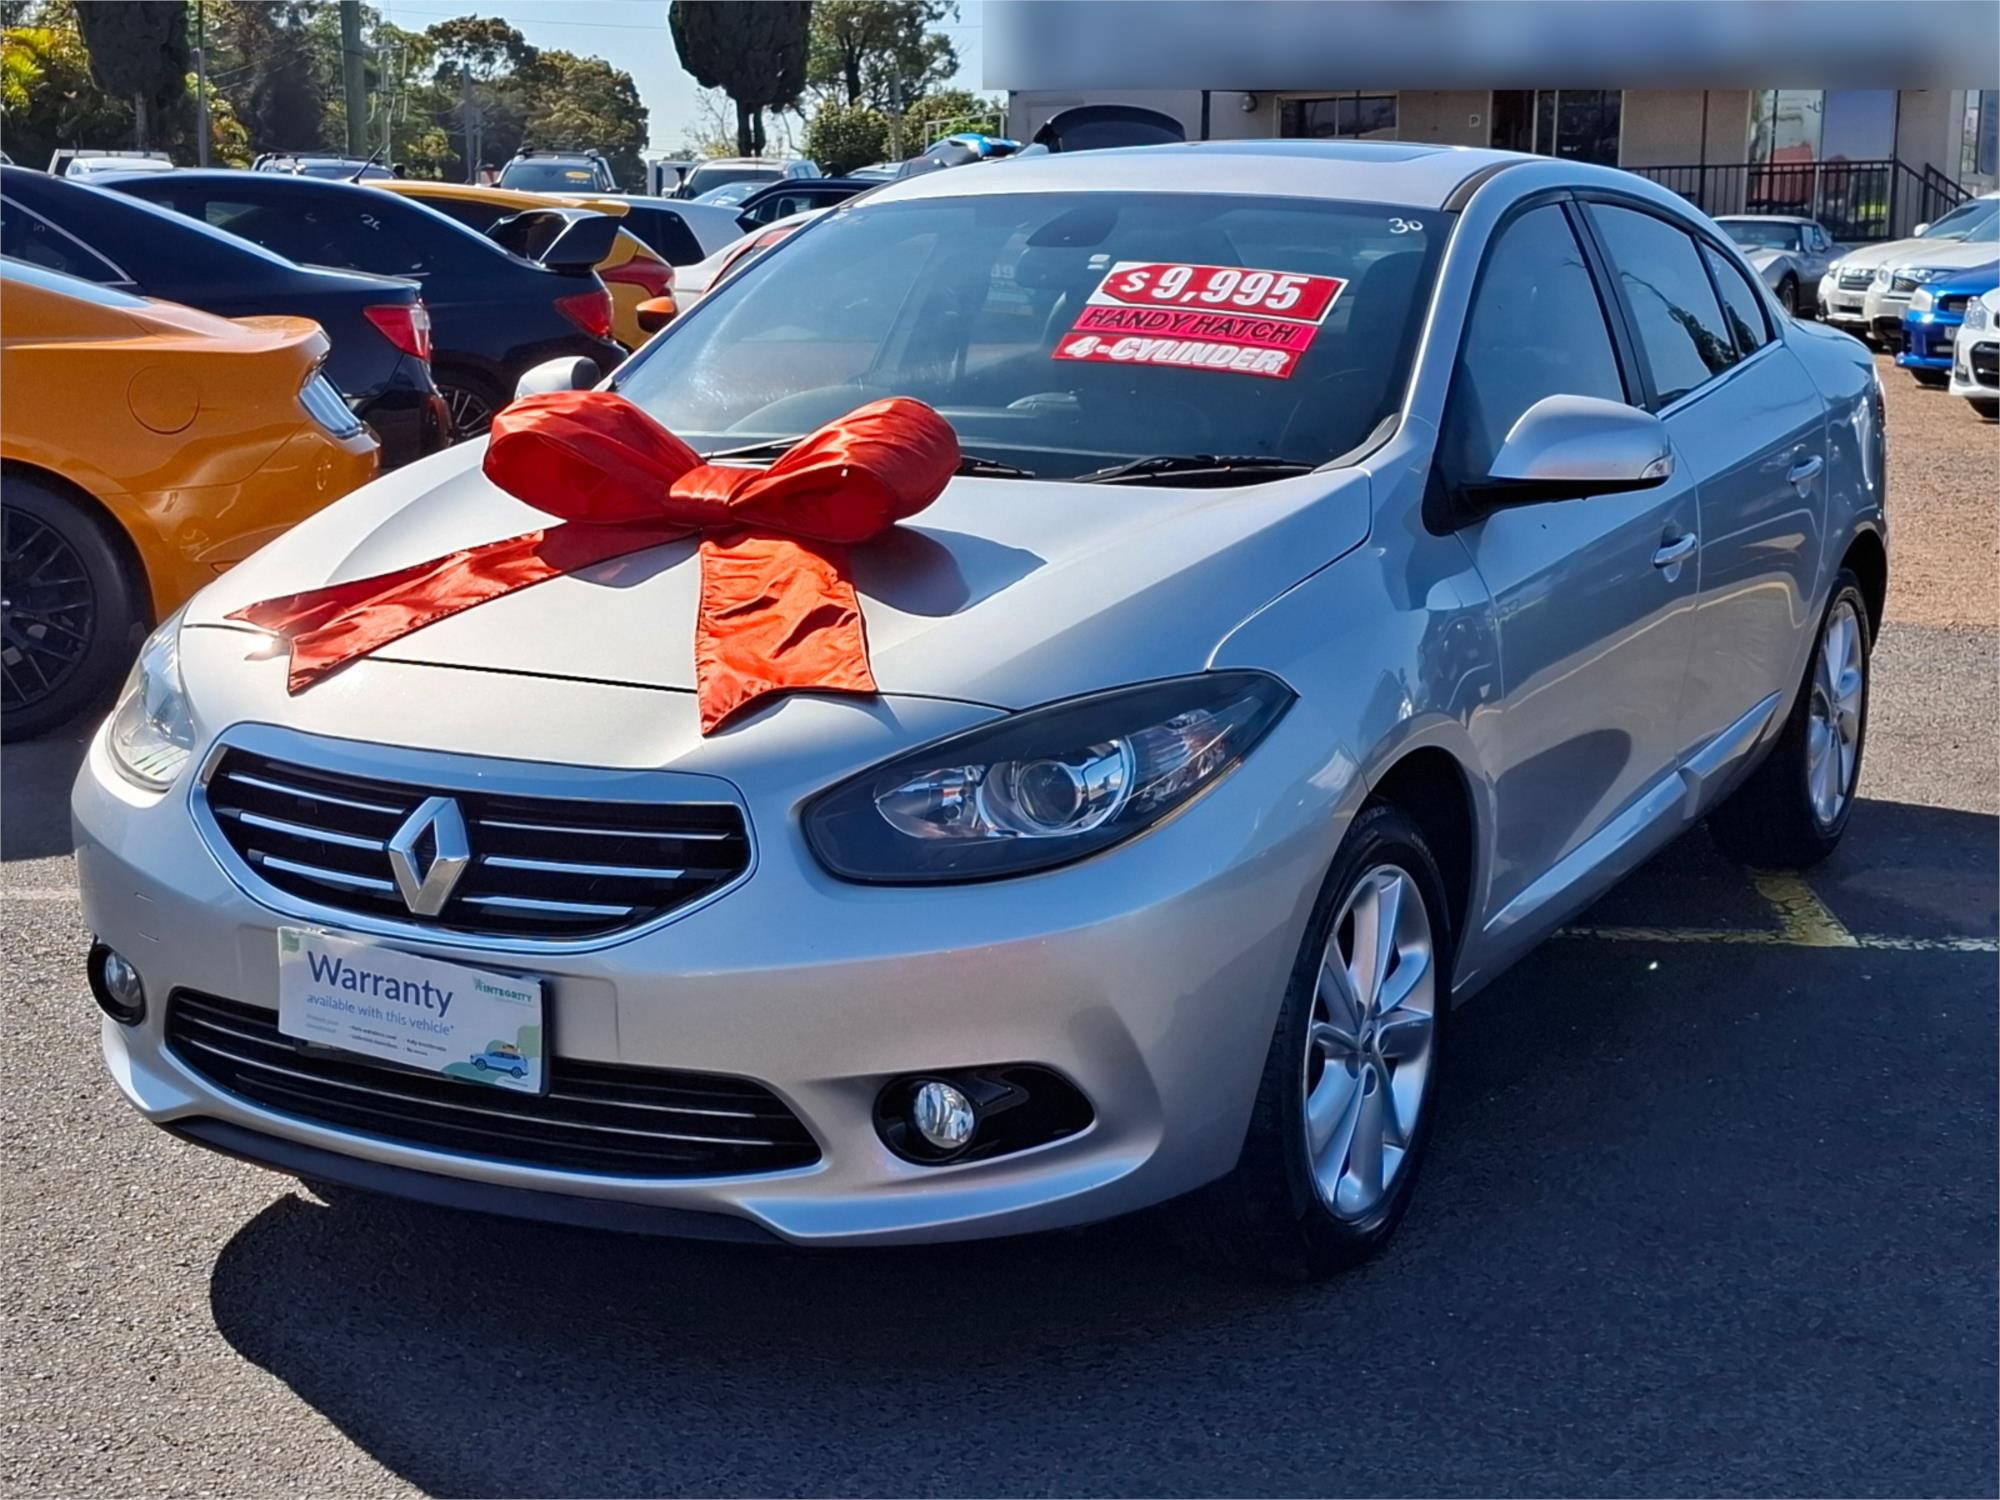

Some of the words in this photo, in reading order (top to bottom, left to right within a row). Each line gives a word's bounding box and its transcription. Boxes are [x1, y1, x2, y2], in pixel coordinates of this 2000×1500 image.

[1388, 217, 1424, 234] 30
[1084, 308, 1191, 333] HANDY
[1190, 316, 1298, 344] HATCH
[1065, 335, 1291, 376] 4-CYLINDER
[307, 949, 454, 1018] Warranty
[482, 984, 533, 1002] INTEGRITY
[305, 993, 356, 1014] available
[358, 1004, 384, 1020] with
[386, 1010, 407, 1026] this
